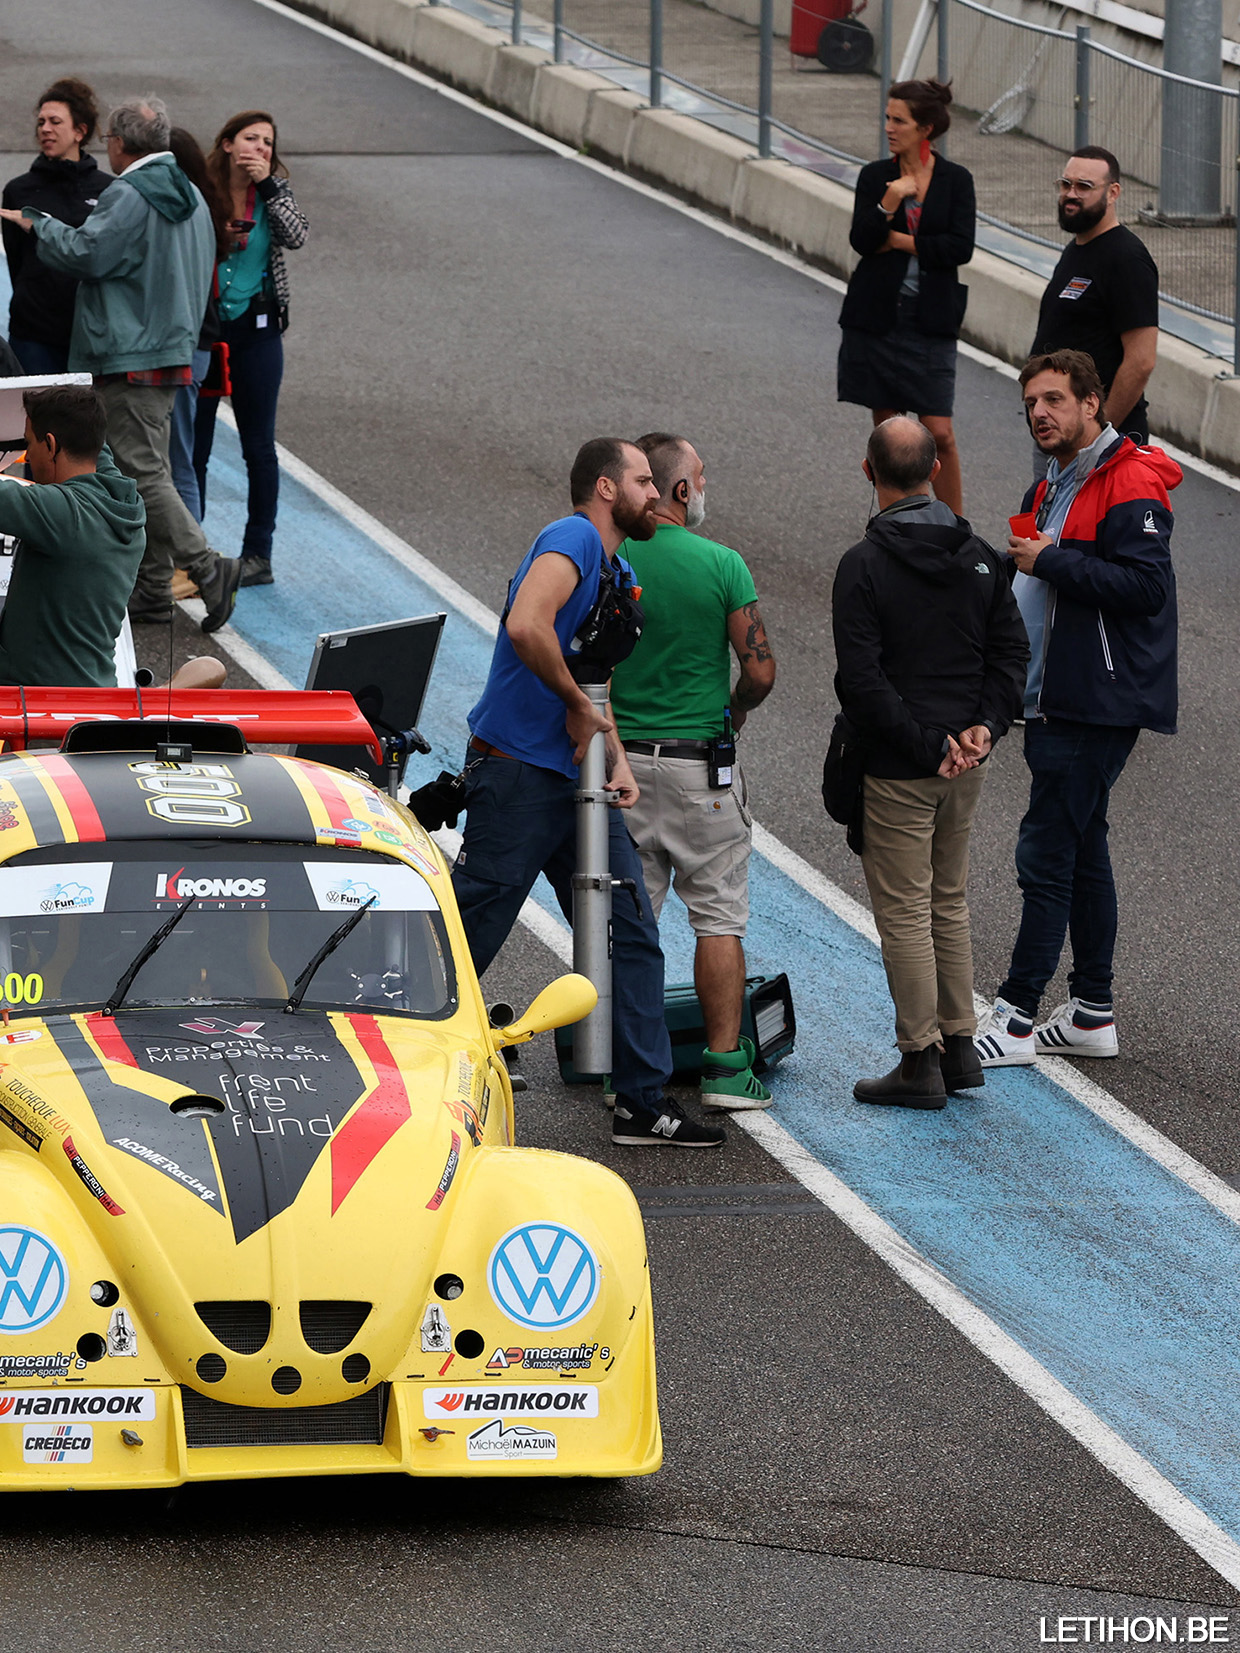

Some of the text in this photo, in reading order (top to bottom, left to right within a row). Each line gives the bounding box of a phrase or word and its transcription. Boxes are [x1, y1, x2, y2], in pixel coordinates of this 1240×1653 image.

[155, 867, 266, 899] KRONOS
[54, 896, 95, 908] FunCup
[146, 1040, 315, 1055] Properties &
[148, 1049, 331, 1063] Management
[5, 1078, 57, 1121] TOUCHEQUE
[48, 1115, 73, 1136] LUX
[232, 1114, 336, 1136] fund
[73, 1155, 105, 1197] PEPPERONI
[439, 1150, 457, 1191] PEPPERONI
[522, 1358, 591, 1370] & motor sports
[7, 1367, 36, 1376] motor
[37, 1367, 68, 1378] sports
[24, 1437, 92, 1451] CREDECO
[504, 1449, 523, 1459] Sport
